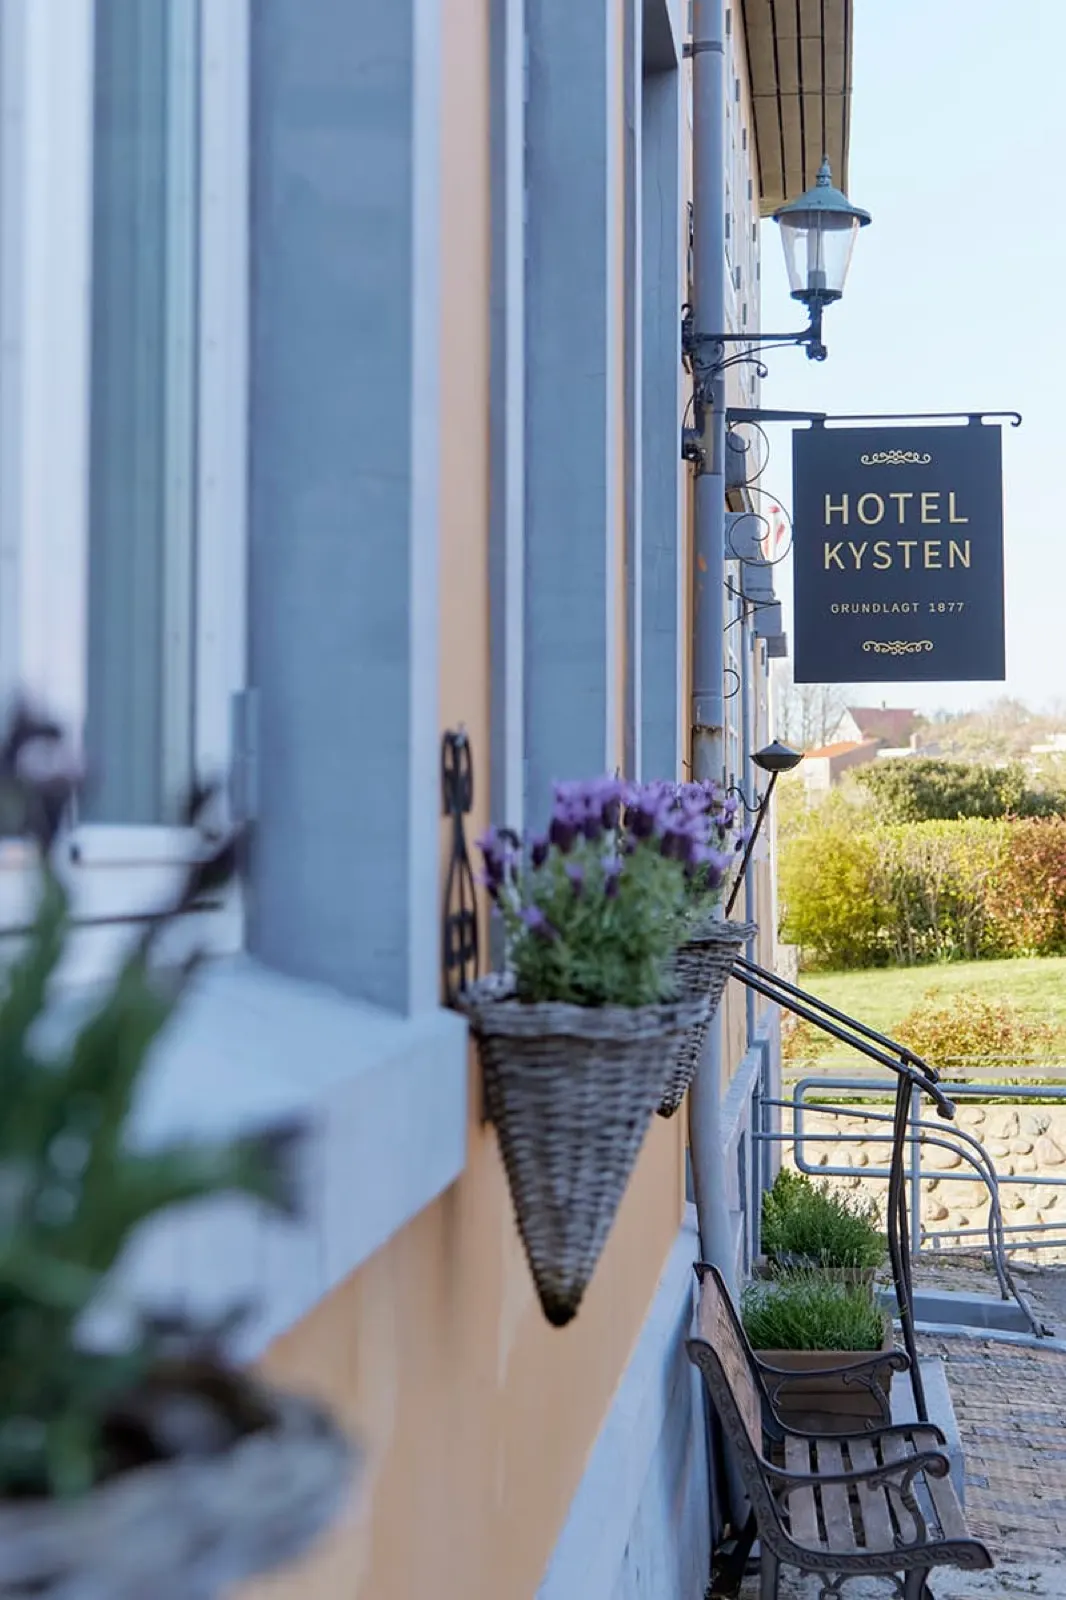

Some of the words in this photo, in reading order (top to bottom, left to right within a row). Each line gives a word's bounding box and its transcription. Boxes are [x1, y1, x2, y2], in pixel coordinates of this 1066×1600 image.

[824, 491, 968, 526] HOTEL
[823, 539, 973, 572] KYSTEN
[830, 602, 919, 614] GRUNDLAGT
[928, 601, 965, 613] 1877
